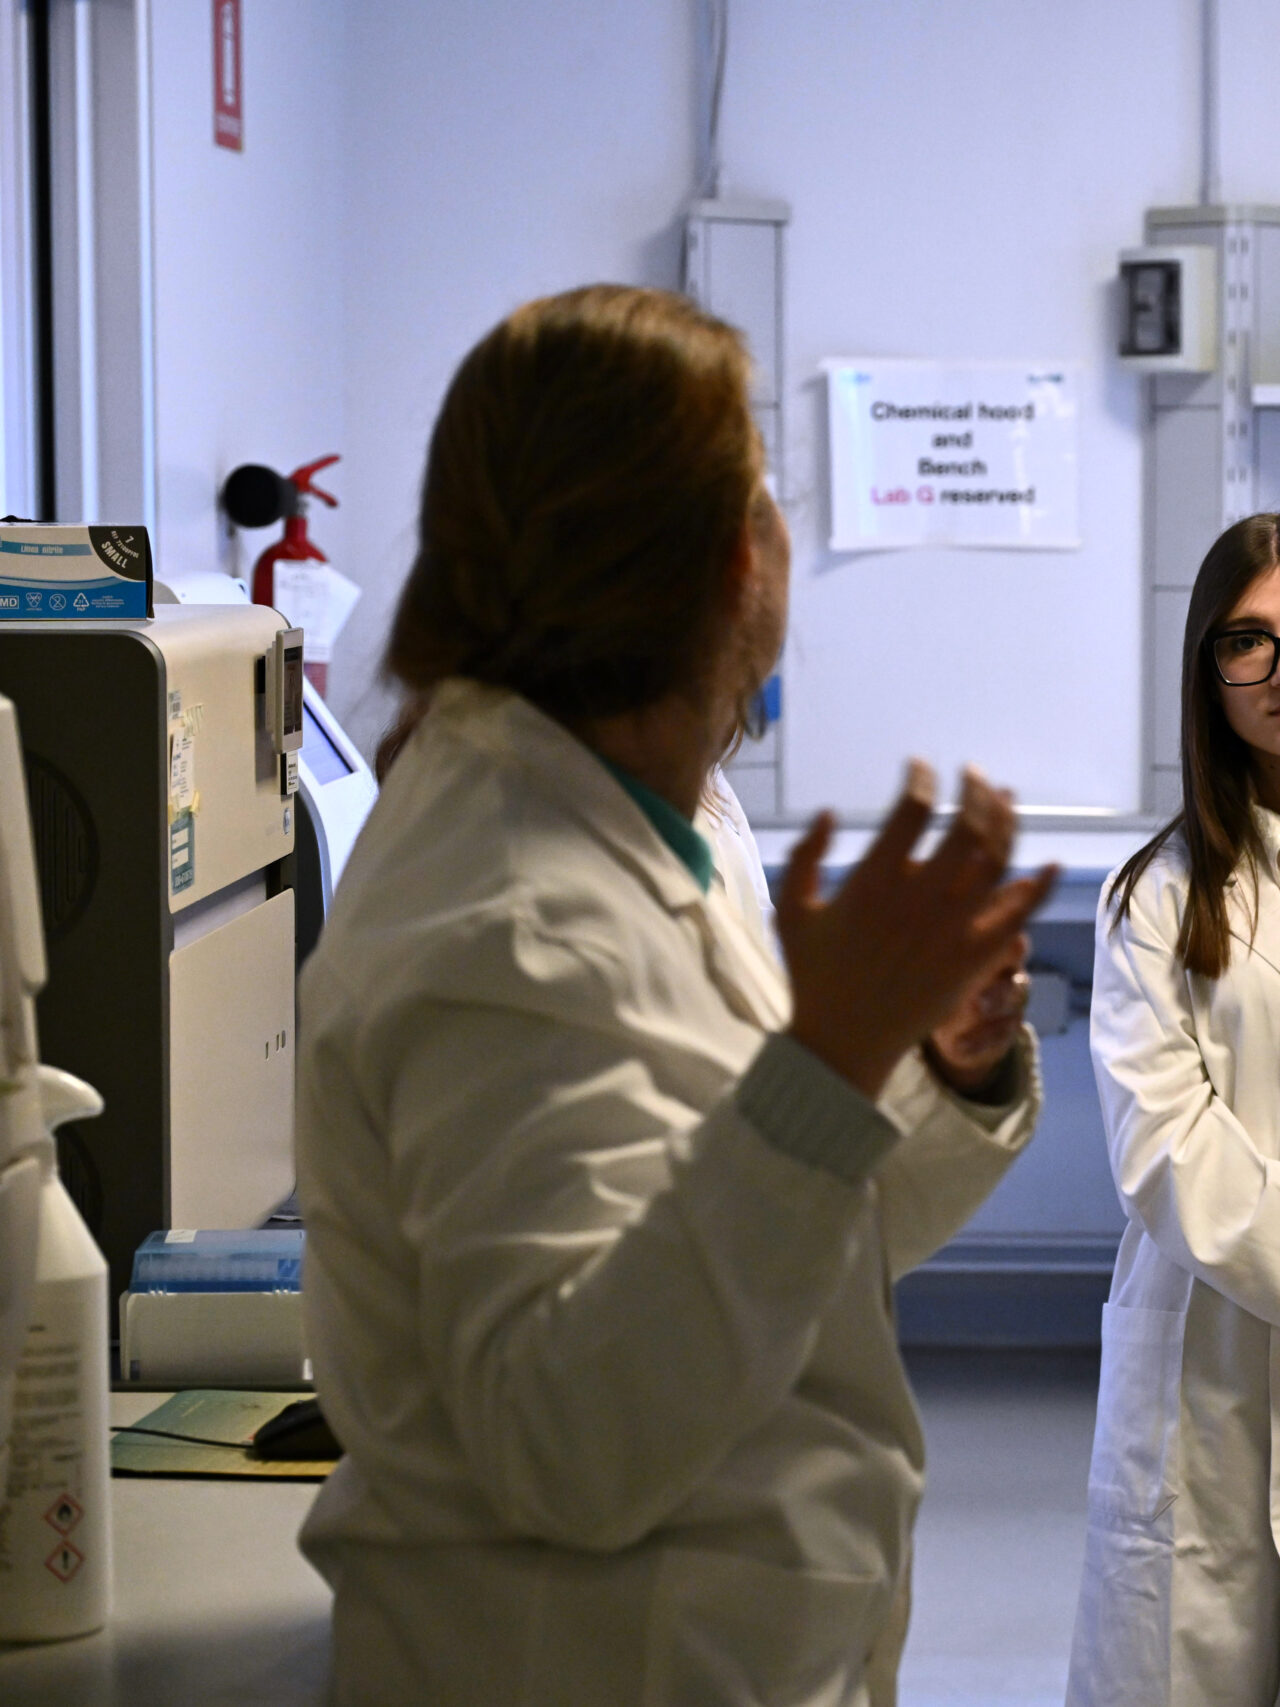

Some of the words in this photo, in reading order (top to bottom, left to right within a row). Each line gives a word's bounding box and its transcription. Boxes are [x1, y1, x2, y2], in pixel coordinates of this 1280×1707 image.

[871, 401, 974, 421] Chemical
[977, 400, 1035, 421] hood
[931, 431, 973, 449] and
[917, 457, 987, 477] Bench
[870, 486, 911, 505] Lab
[939, 485, 1036, 505] reserved
[101, 541, 128, 569] SMALL
[0, 598, 17, 607] MD
